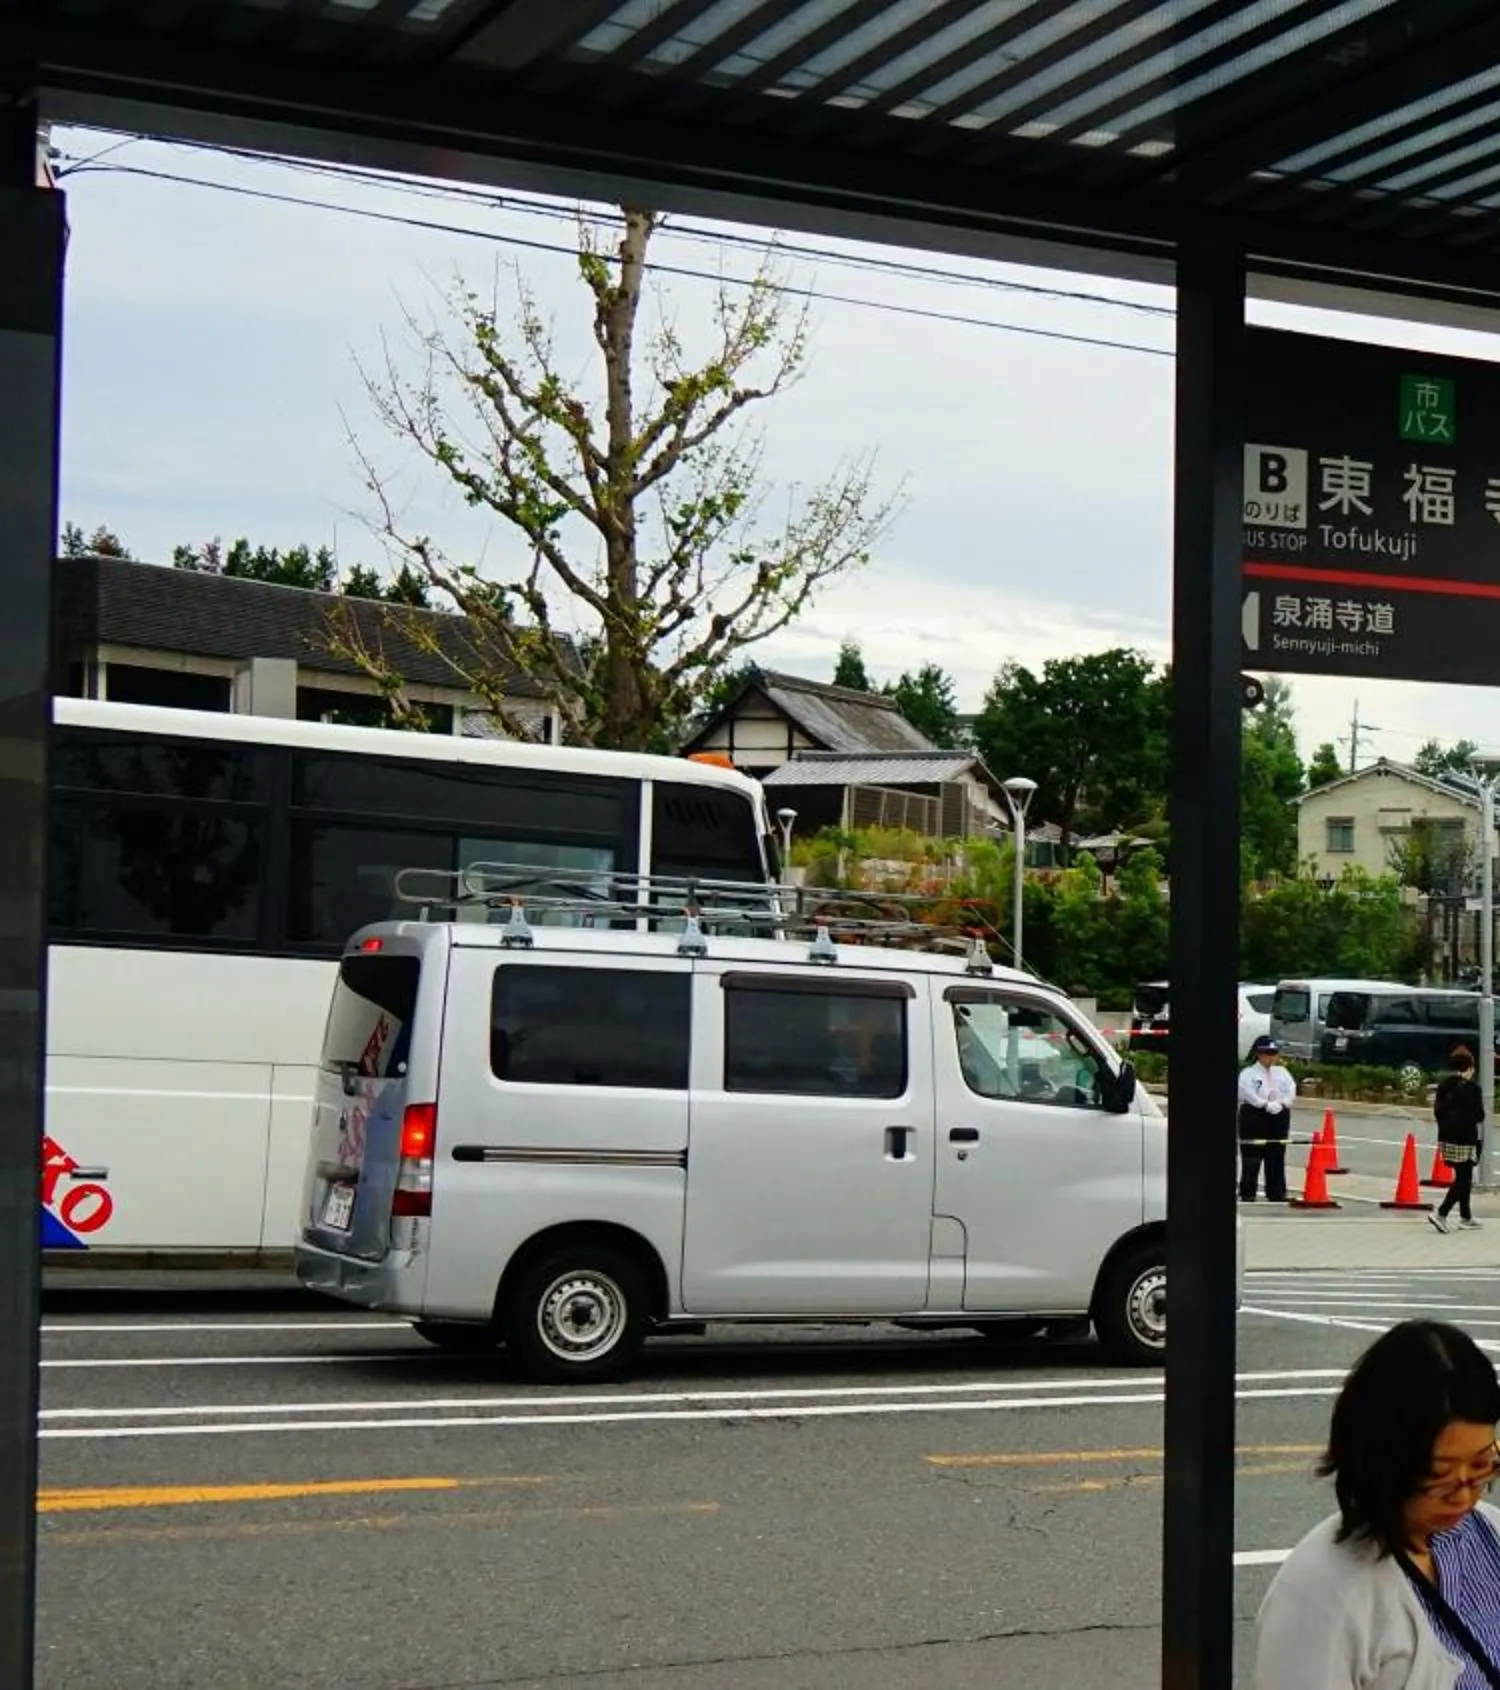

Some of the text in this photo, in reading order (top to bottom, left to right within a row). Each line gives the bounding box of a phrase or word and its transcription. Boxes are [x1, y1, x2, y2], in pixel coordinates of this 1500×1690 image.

[1415, 381, 1441, 409] 市
[1404, 410, 1452, 438] バス
[1260, 453, 1287, 493] B
[1245, 501, 1302, 522] のりば
[1244, 530, 1307, 552] US STOP
[1319, 524, 1418, 561] Tofukuji
[1272, 594, 1396, 635] 泉涌寺道
[1272, 634, 1381, 657] Sennyuji-michi
